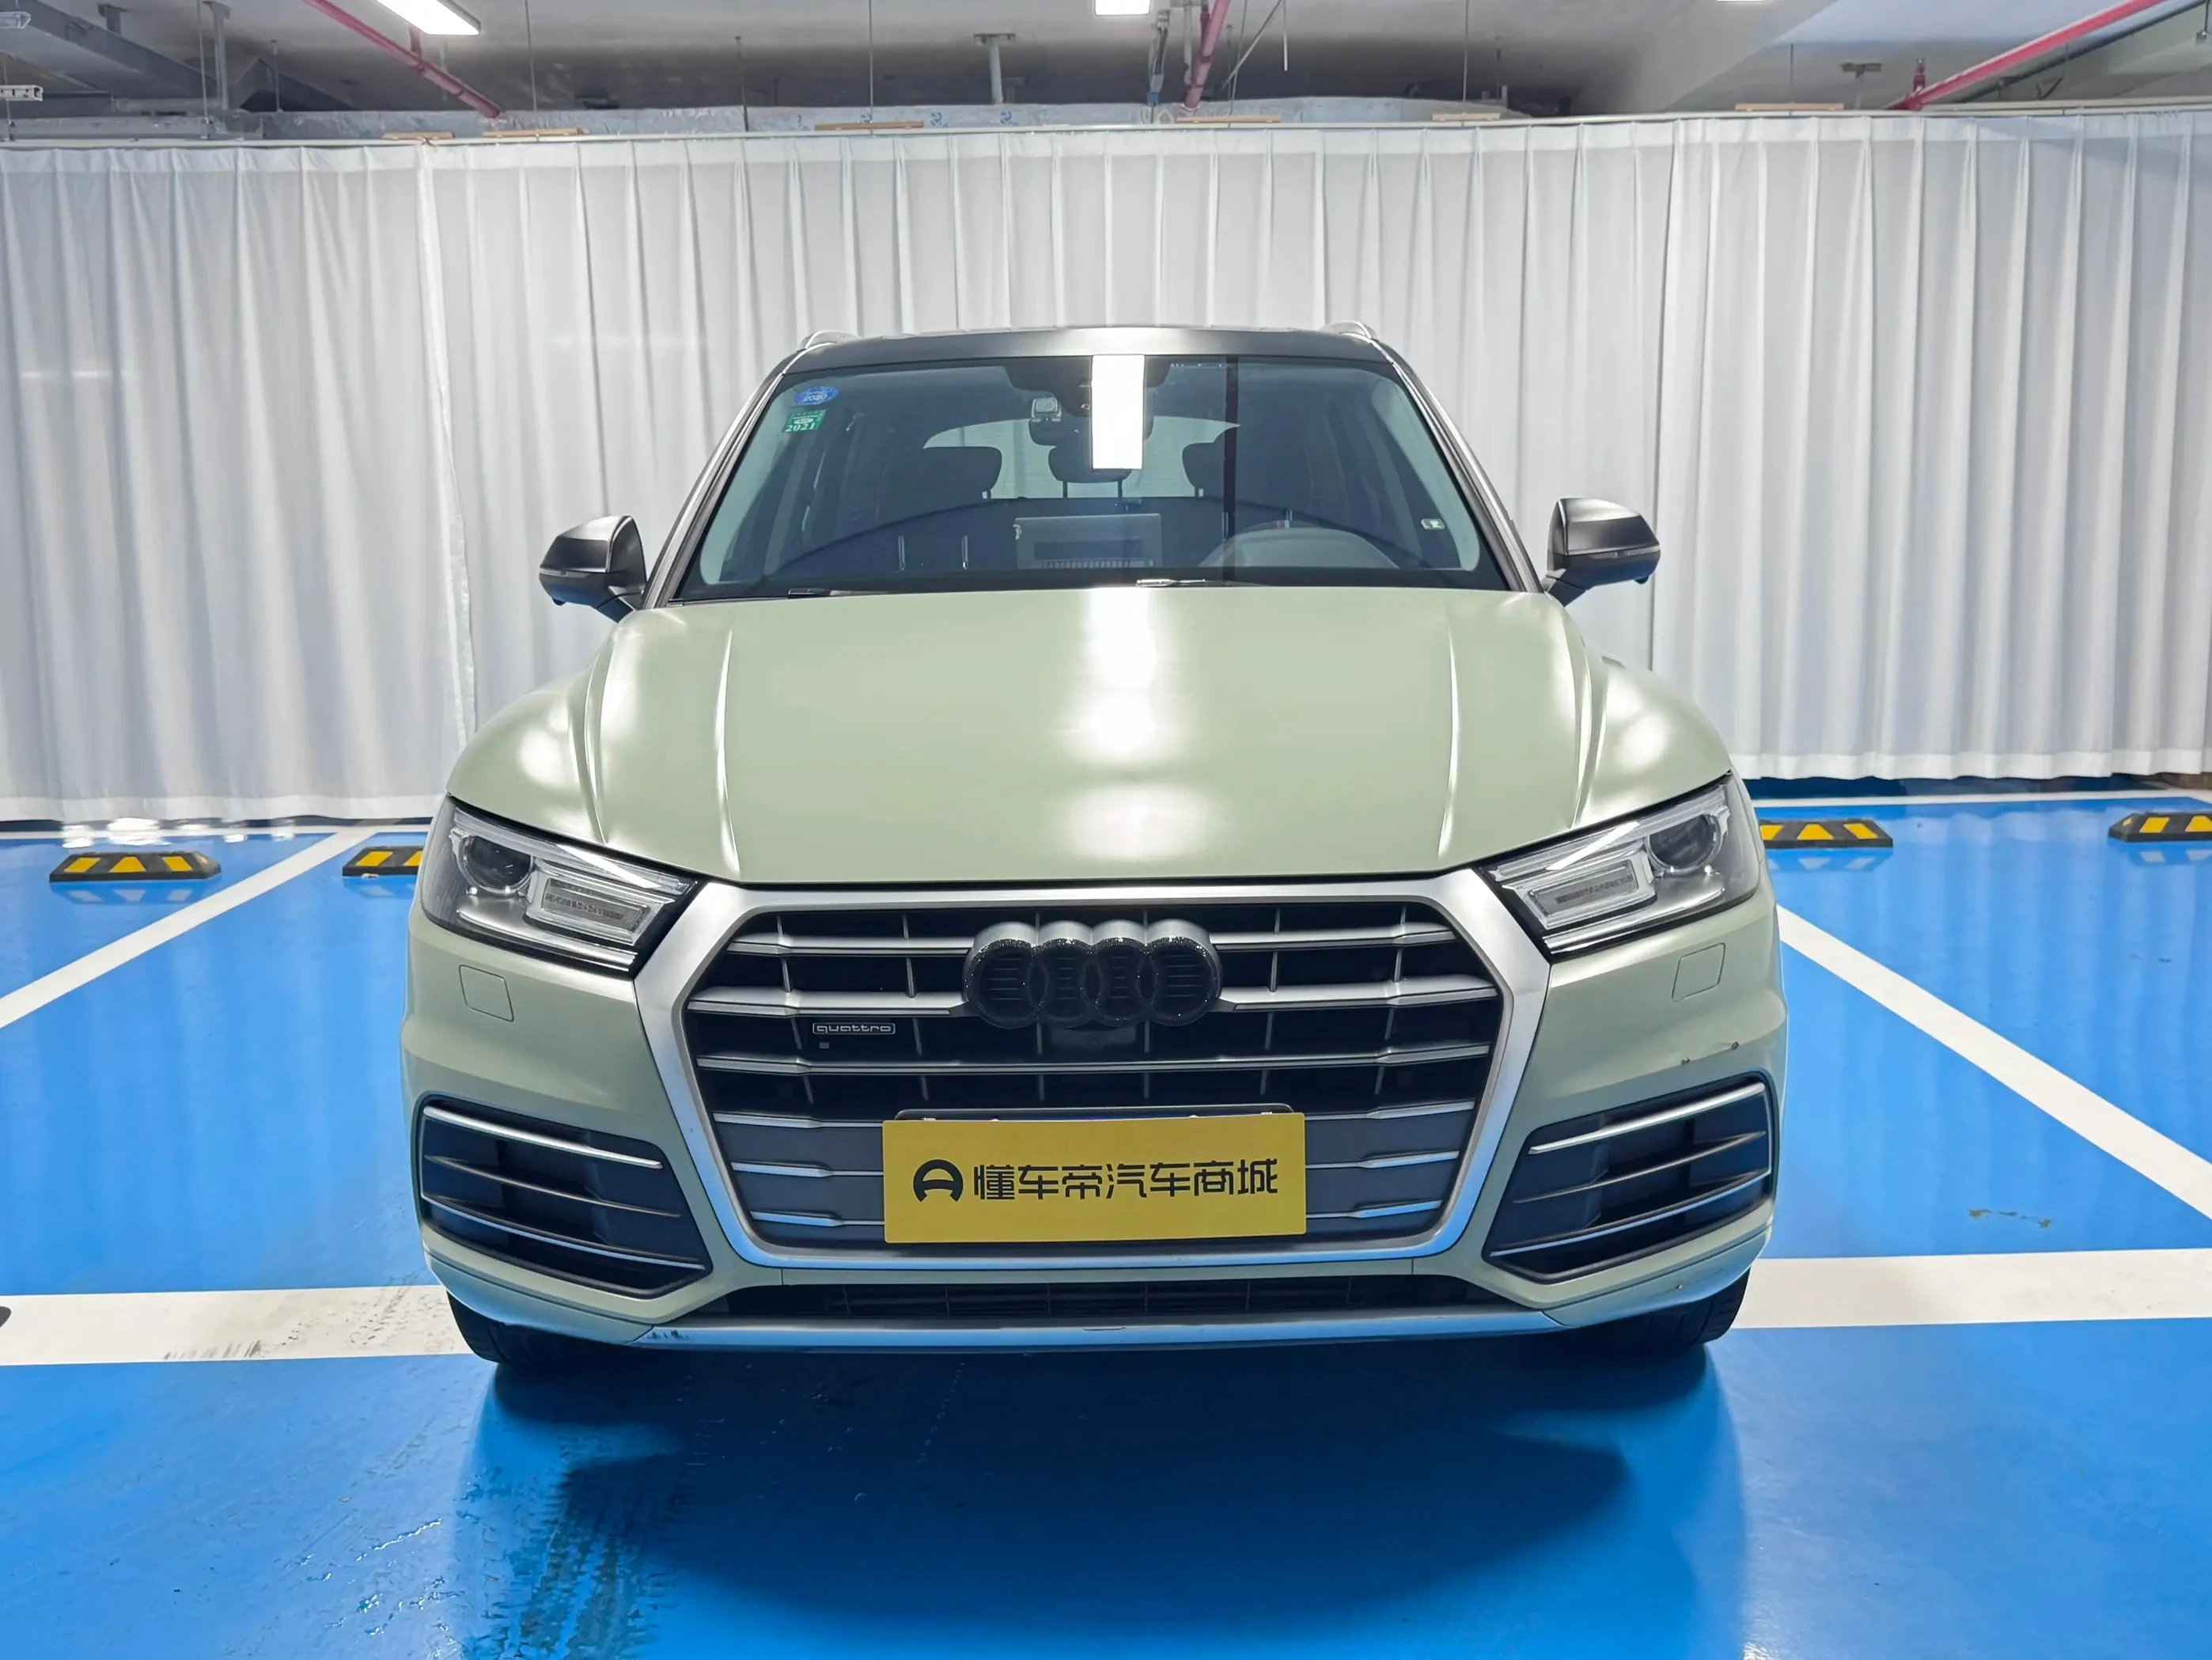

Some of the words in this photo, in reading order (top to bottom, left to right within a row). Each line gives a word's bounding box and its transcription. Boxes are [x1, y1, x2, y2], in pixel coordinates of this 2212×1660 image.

[785, 423, 815, 432] 2021
[816, 1025, 891, 1033] quattro
[973, 1158, 1278, 1200] 懂车帝汽车商城
